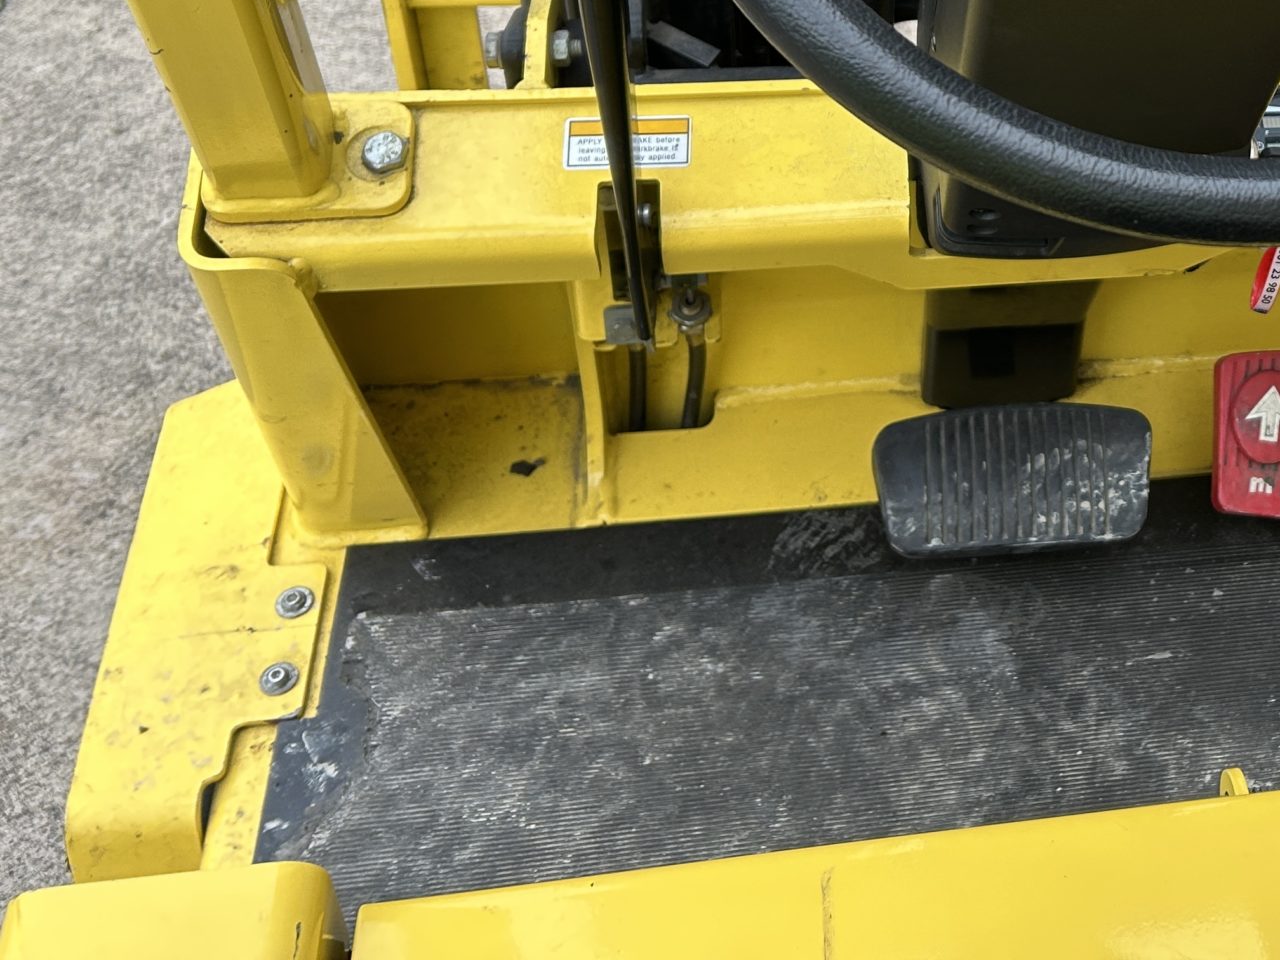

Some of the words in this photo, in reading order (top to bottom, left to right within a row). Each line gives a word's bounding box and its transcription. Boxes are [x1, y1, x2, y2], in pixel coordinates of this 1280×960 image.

[578, 146, 606, 154] leaving
[648, 152, 676, 161] applied
[1266, 282, 1277, 293] 98
[1261, 294, 1273, 304] 50
